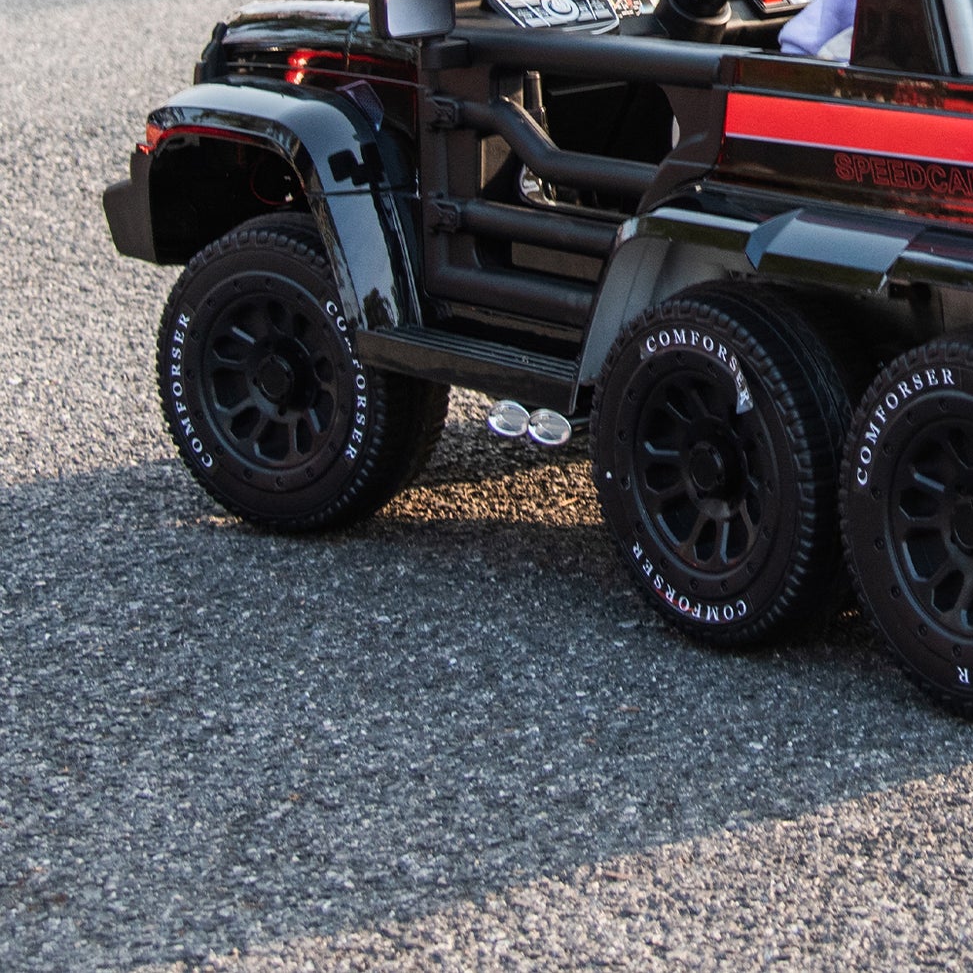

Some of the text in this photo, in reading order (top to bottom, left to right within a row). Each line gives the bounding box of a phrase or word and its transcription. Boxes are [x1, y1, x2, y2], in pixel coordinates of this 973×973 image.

[171, 313, 214, 468] COMFORSER
[856, 368, 954, 486] COMFORSER
[632, 541, 747, 622] COMFORSER
